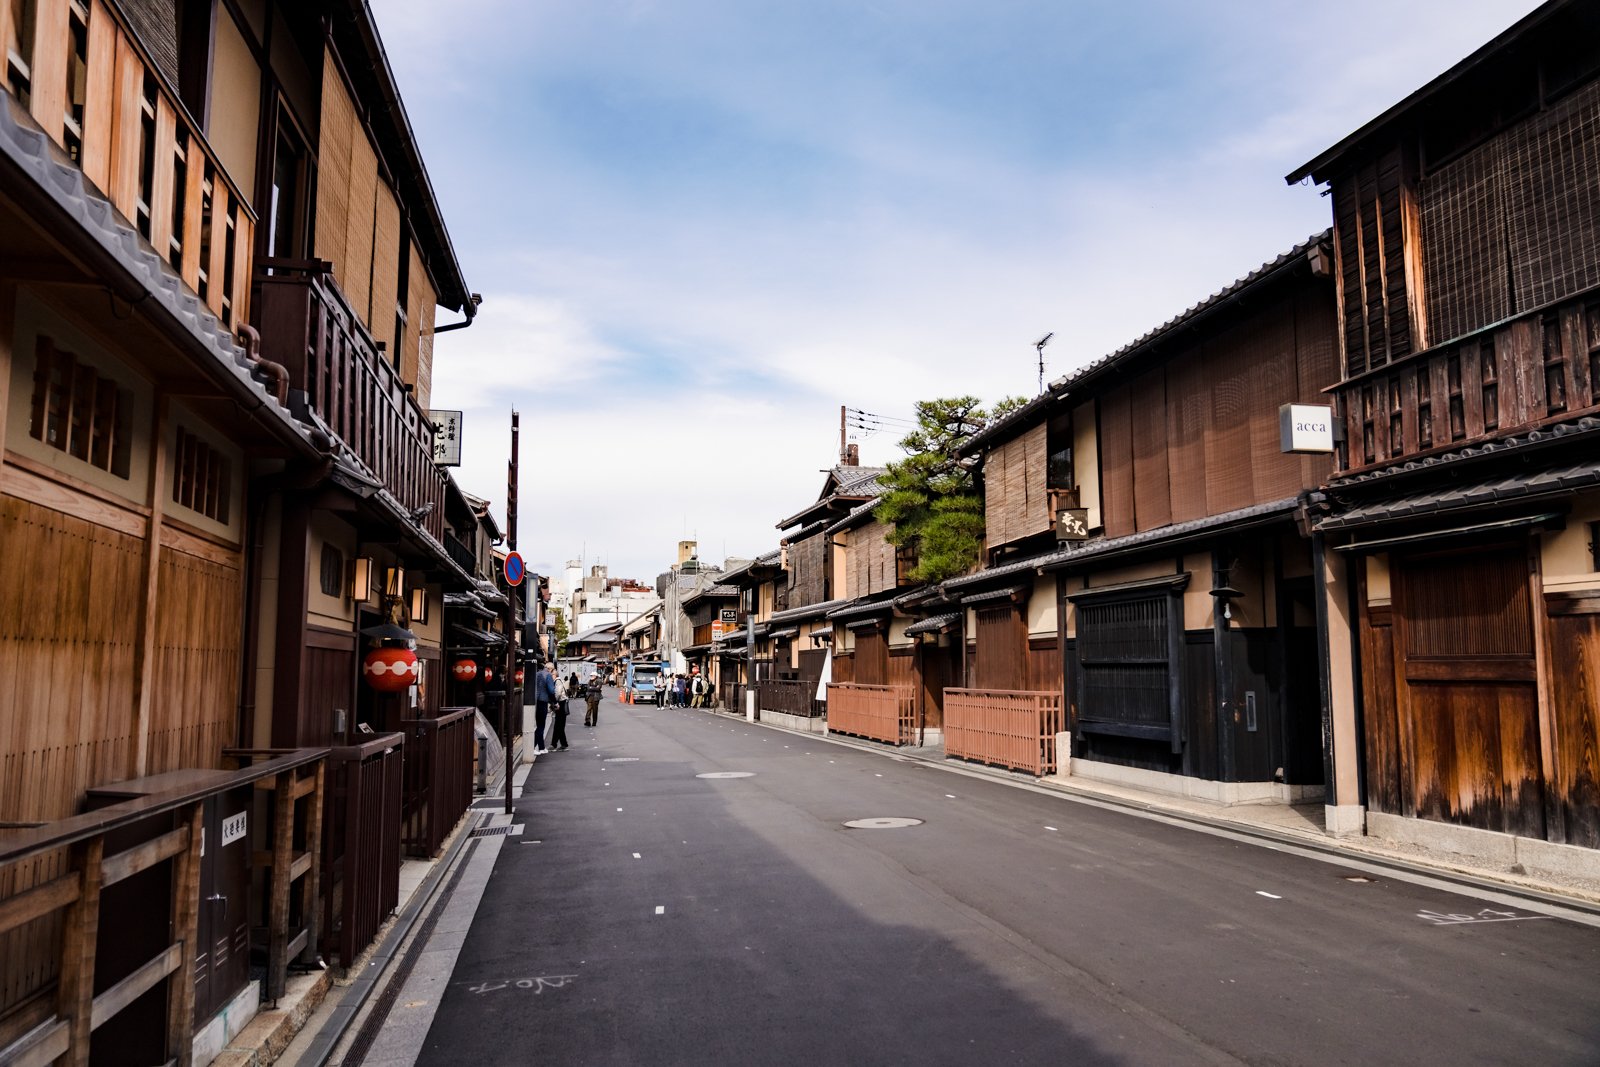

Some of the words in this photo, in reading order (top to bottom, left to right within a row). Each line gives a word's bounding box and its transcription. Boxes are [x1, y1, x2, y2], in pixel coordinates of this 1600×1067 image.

[448, 417, 456, 441] 京料理
[1297, 422, 1326, 432] acca
